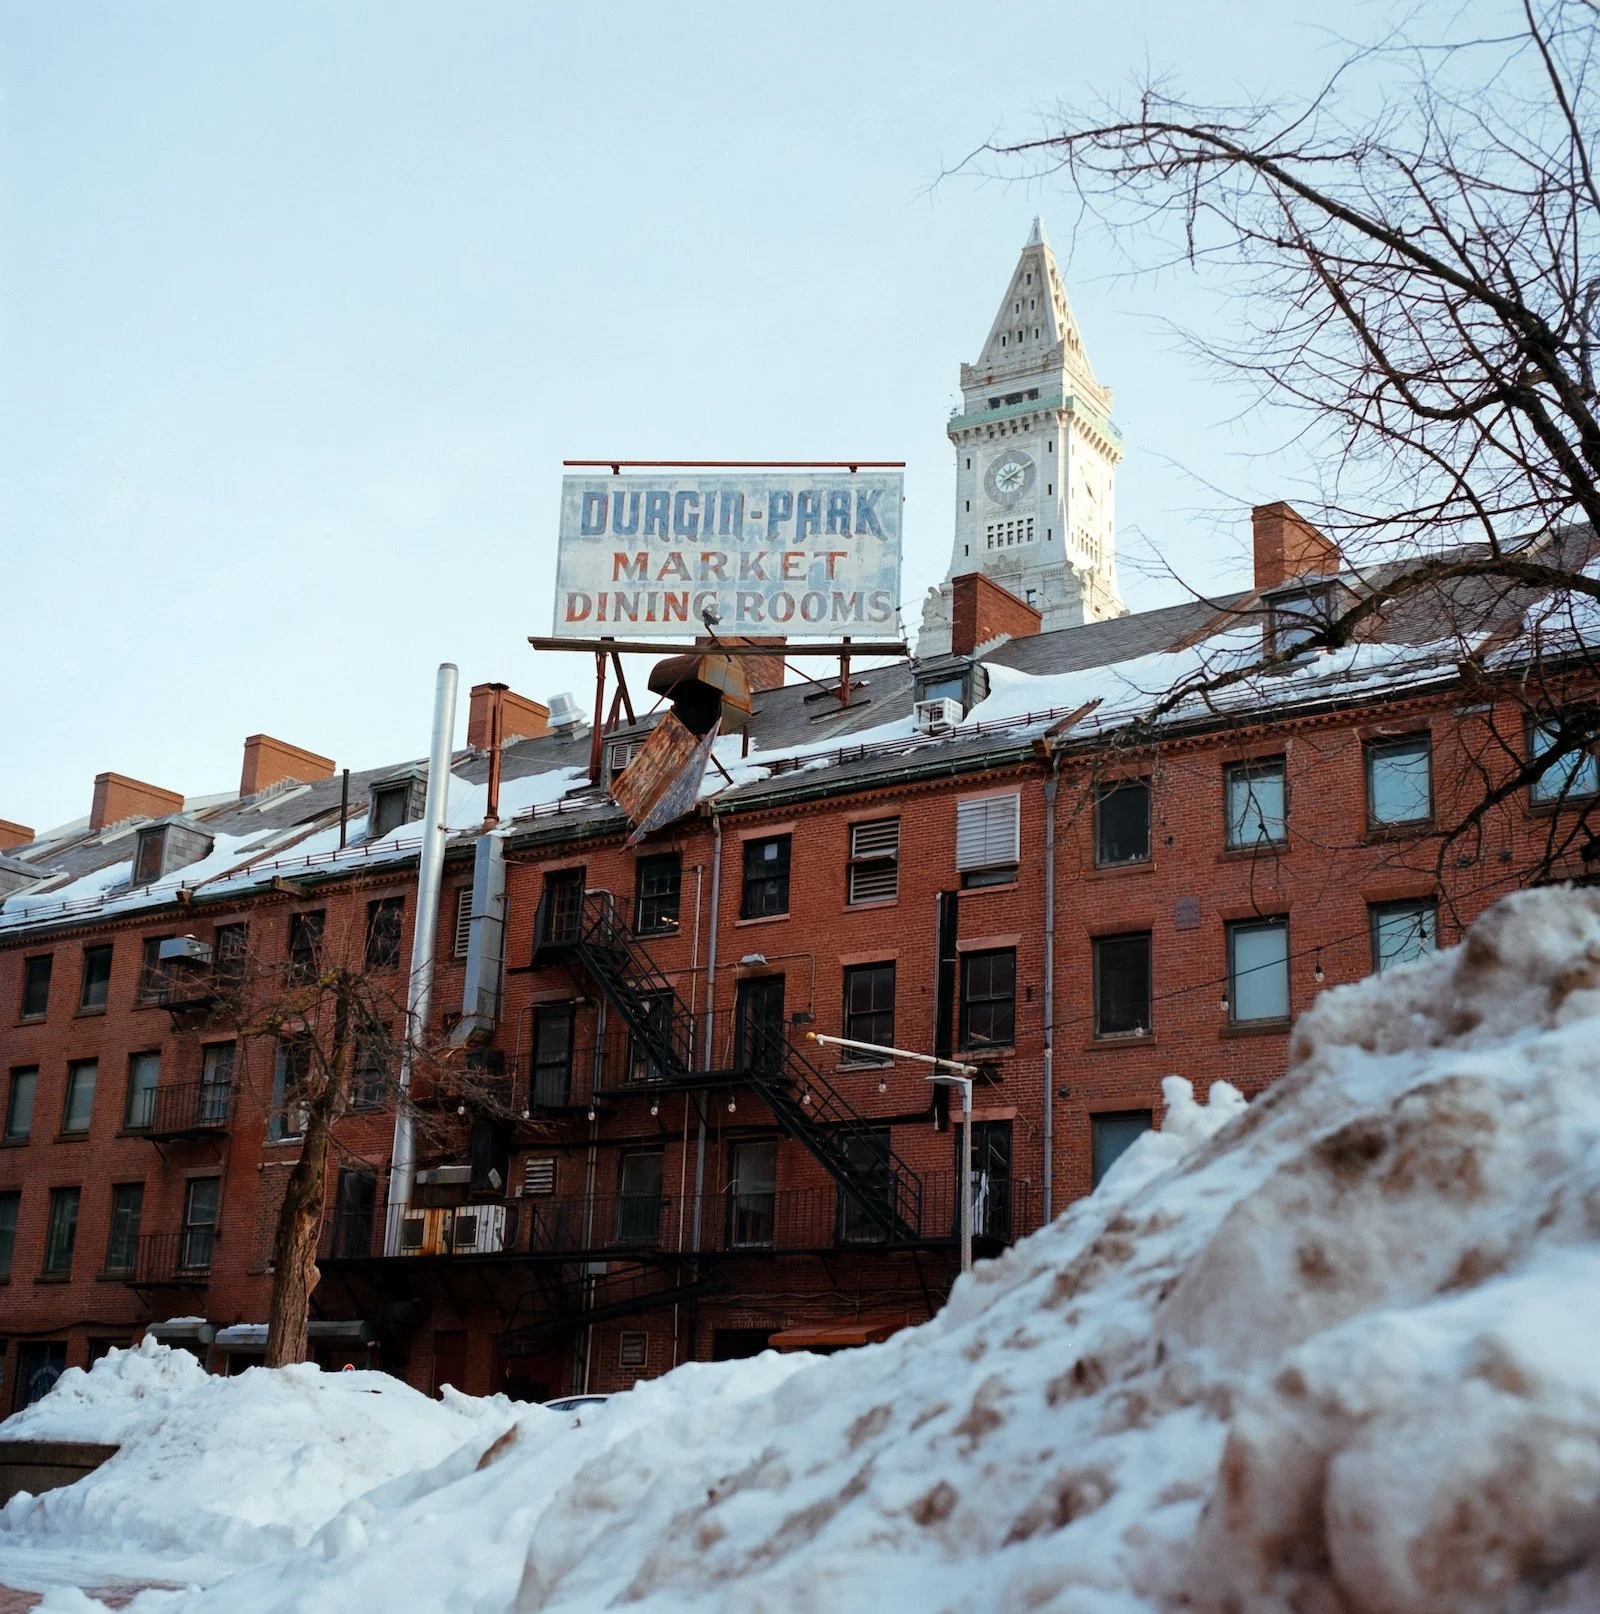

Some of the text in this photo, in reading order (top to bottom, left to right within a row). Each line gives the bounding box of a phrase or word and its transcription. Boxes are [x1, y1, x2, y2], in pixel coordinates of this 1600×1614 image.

[580, 489, 888, 544] DURGIN-PARK
[612, 551, 848, 583] MARKET
[564, 590, 894, 624] DINING ROOMS
